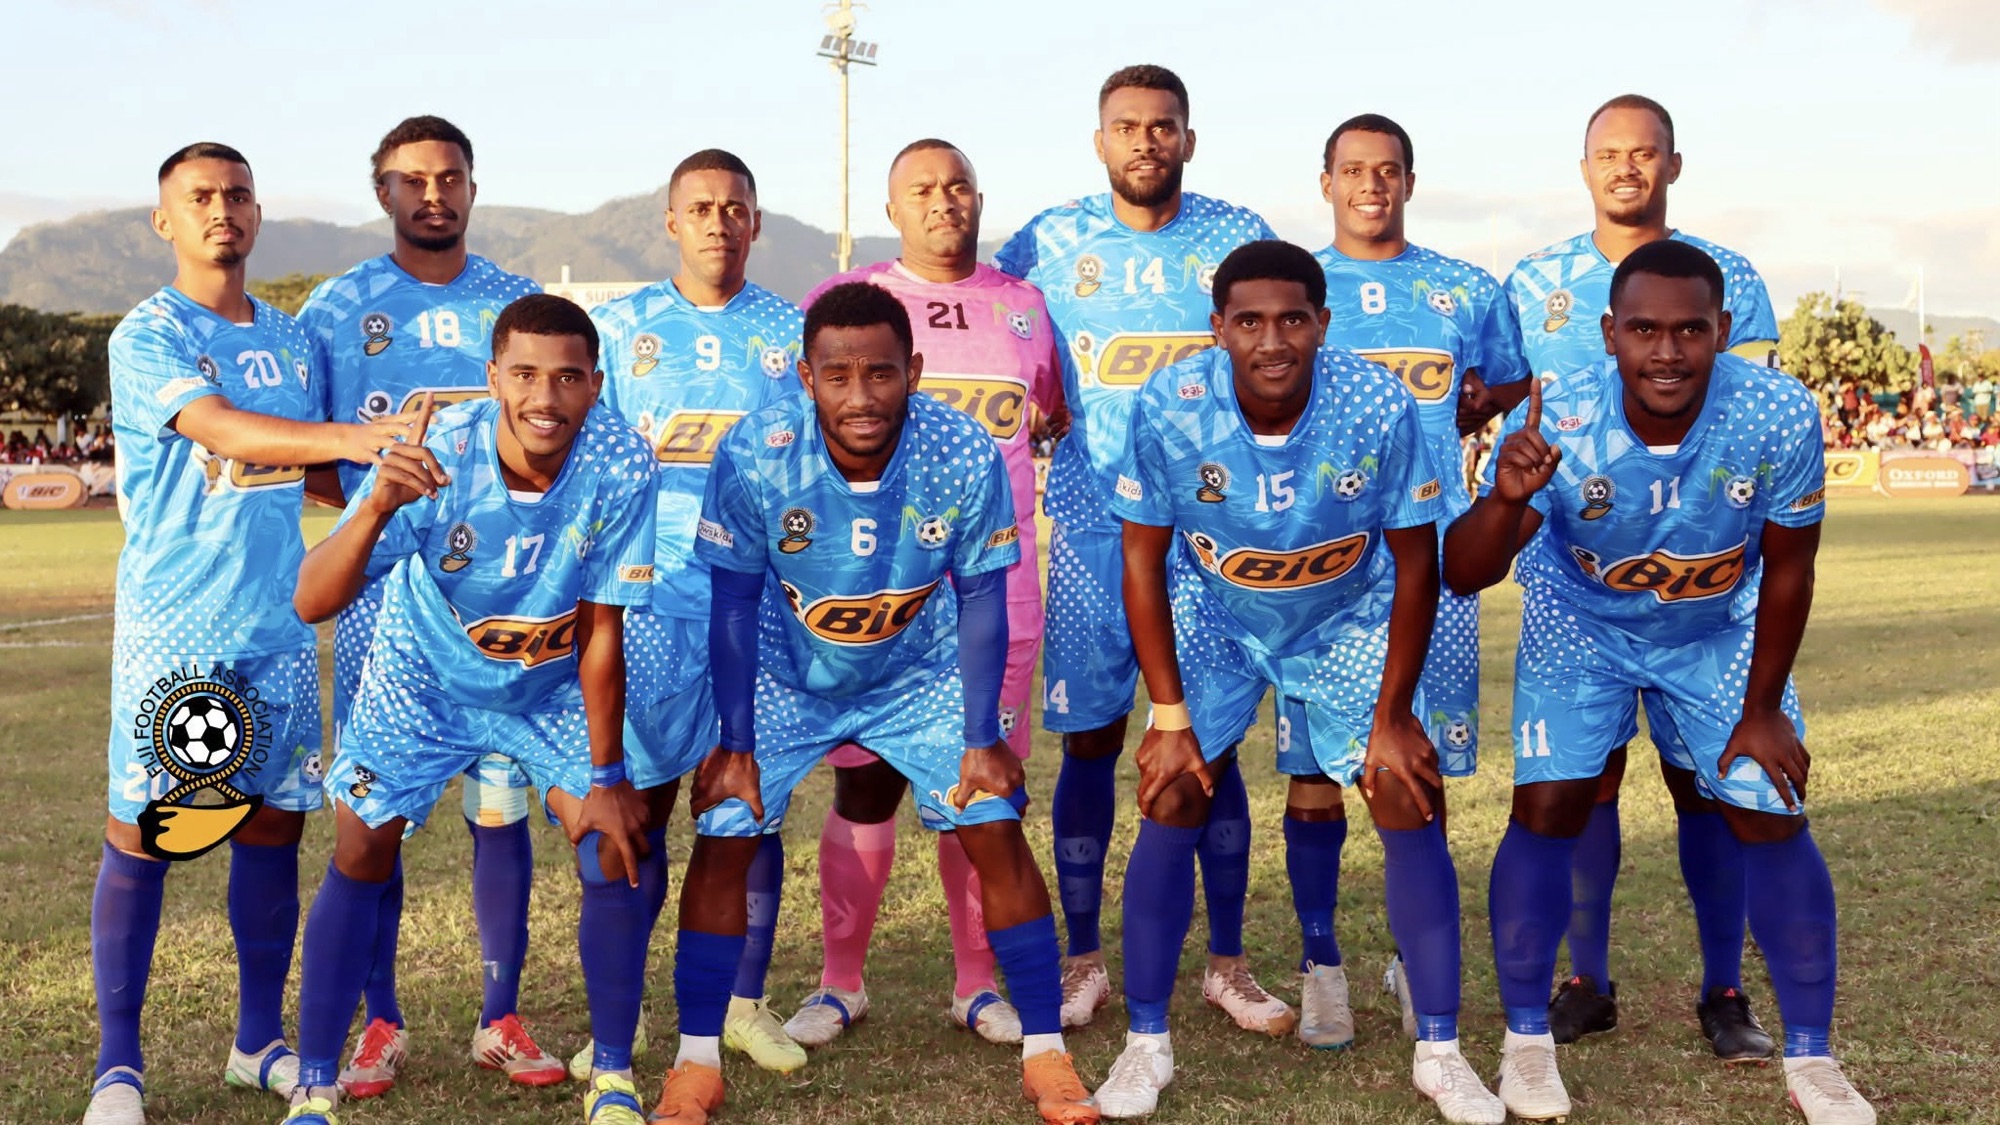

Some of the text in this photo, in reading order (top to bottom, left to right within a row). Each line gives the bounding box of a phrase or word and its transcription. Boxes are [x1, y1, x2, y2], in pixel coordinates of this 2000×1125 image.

[1124, 257, 1165, 294] 14
[927, 302, 969, 330] 21
[1360, 282, 1386, 314] 8
[417, 311, 461, 348] 18
[236, 350, 283, 389] 20
[695, 335, 721, 370] 9
[1378, 360, 1452, 391] iC
[1255, 470, 1295, 512] 15
[1650, 476, 1680, 515] 11
[501, 533, 545, 578] 17
[852, 518, 877, 556] 6
[1520, 718, 1551, 758] 11
